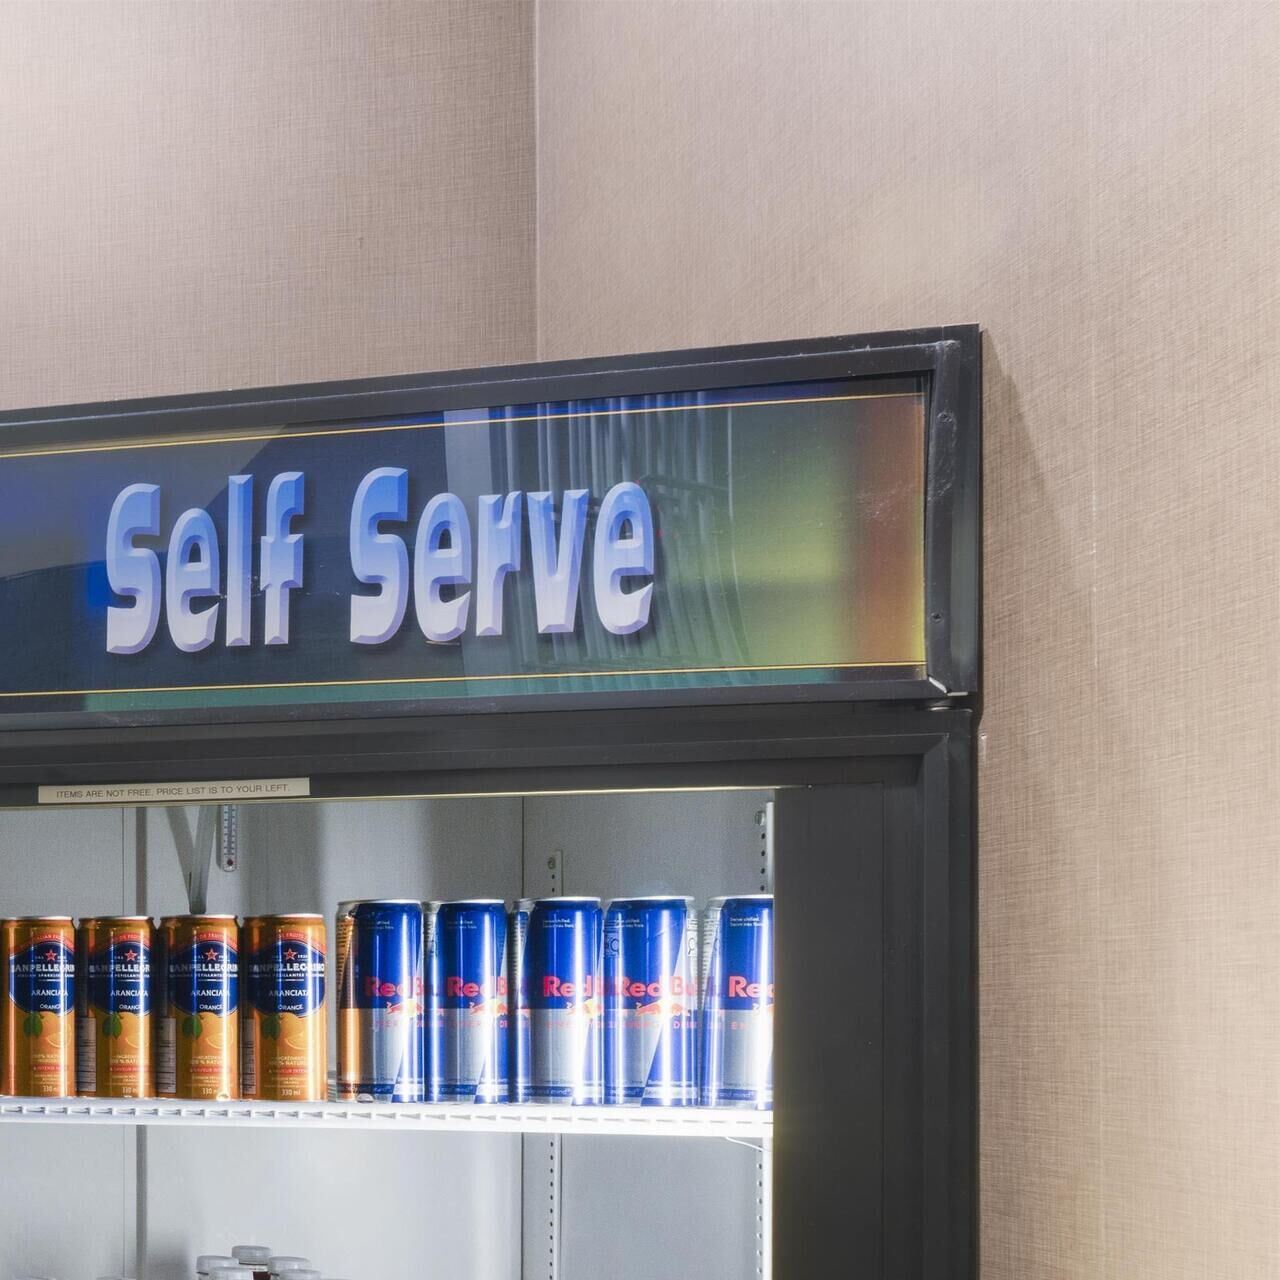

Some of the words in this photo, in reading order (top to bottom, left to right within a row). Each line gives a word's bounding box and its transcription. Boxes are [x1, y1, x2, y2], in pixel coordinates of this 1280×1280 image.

[105, 471, 305, 655] Self
[349, 465, 654, 645] Serve
[56, 790, 83, 799] ITEMS
[85, 789, 104, 798] ARE
[106, 789, 125, 798] NOT
[156, 787, 183, 796] PRICE
[186, 786, 206, 795] LIST
[208, 786, 218, 795] IS
[220, 785, 234, 794] TO
[235, 784, 263, 793] YOUR
[614, 975, 668, 997] Red
[30, 989, 69, 997] ARANCIATA
[110, 989, 149, 997] ARANCIATA
[268, 990, 312, 998] ARANCIATA
